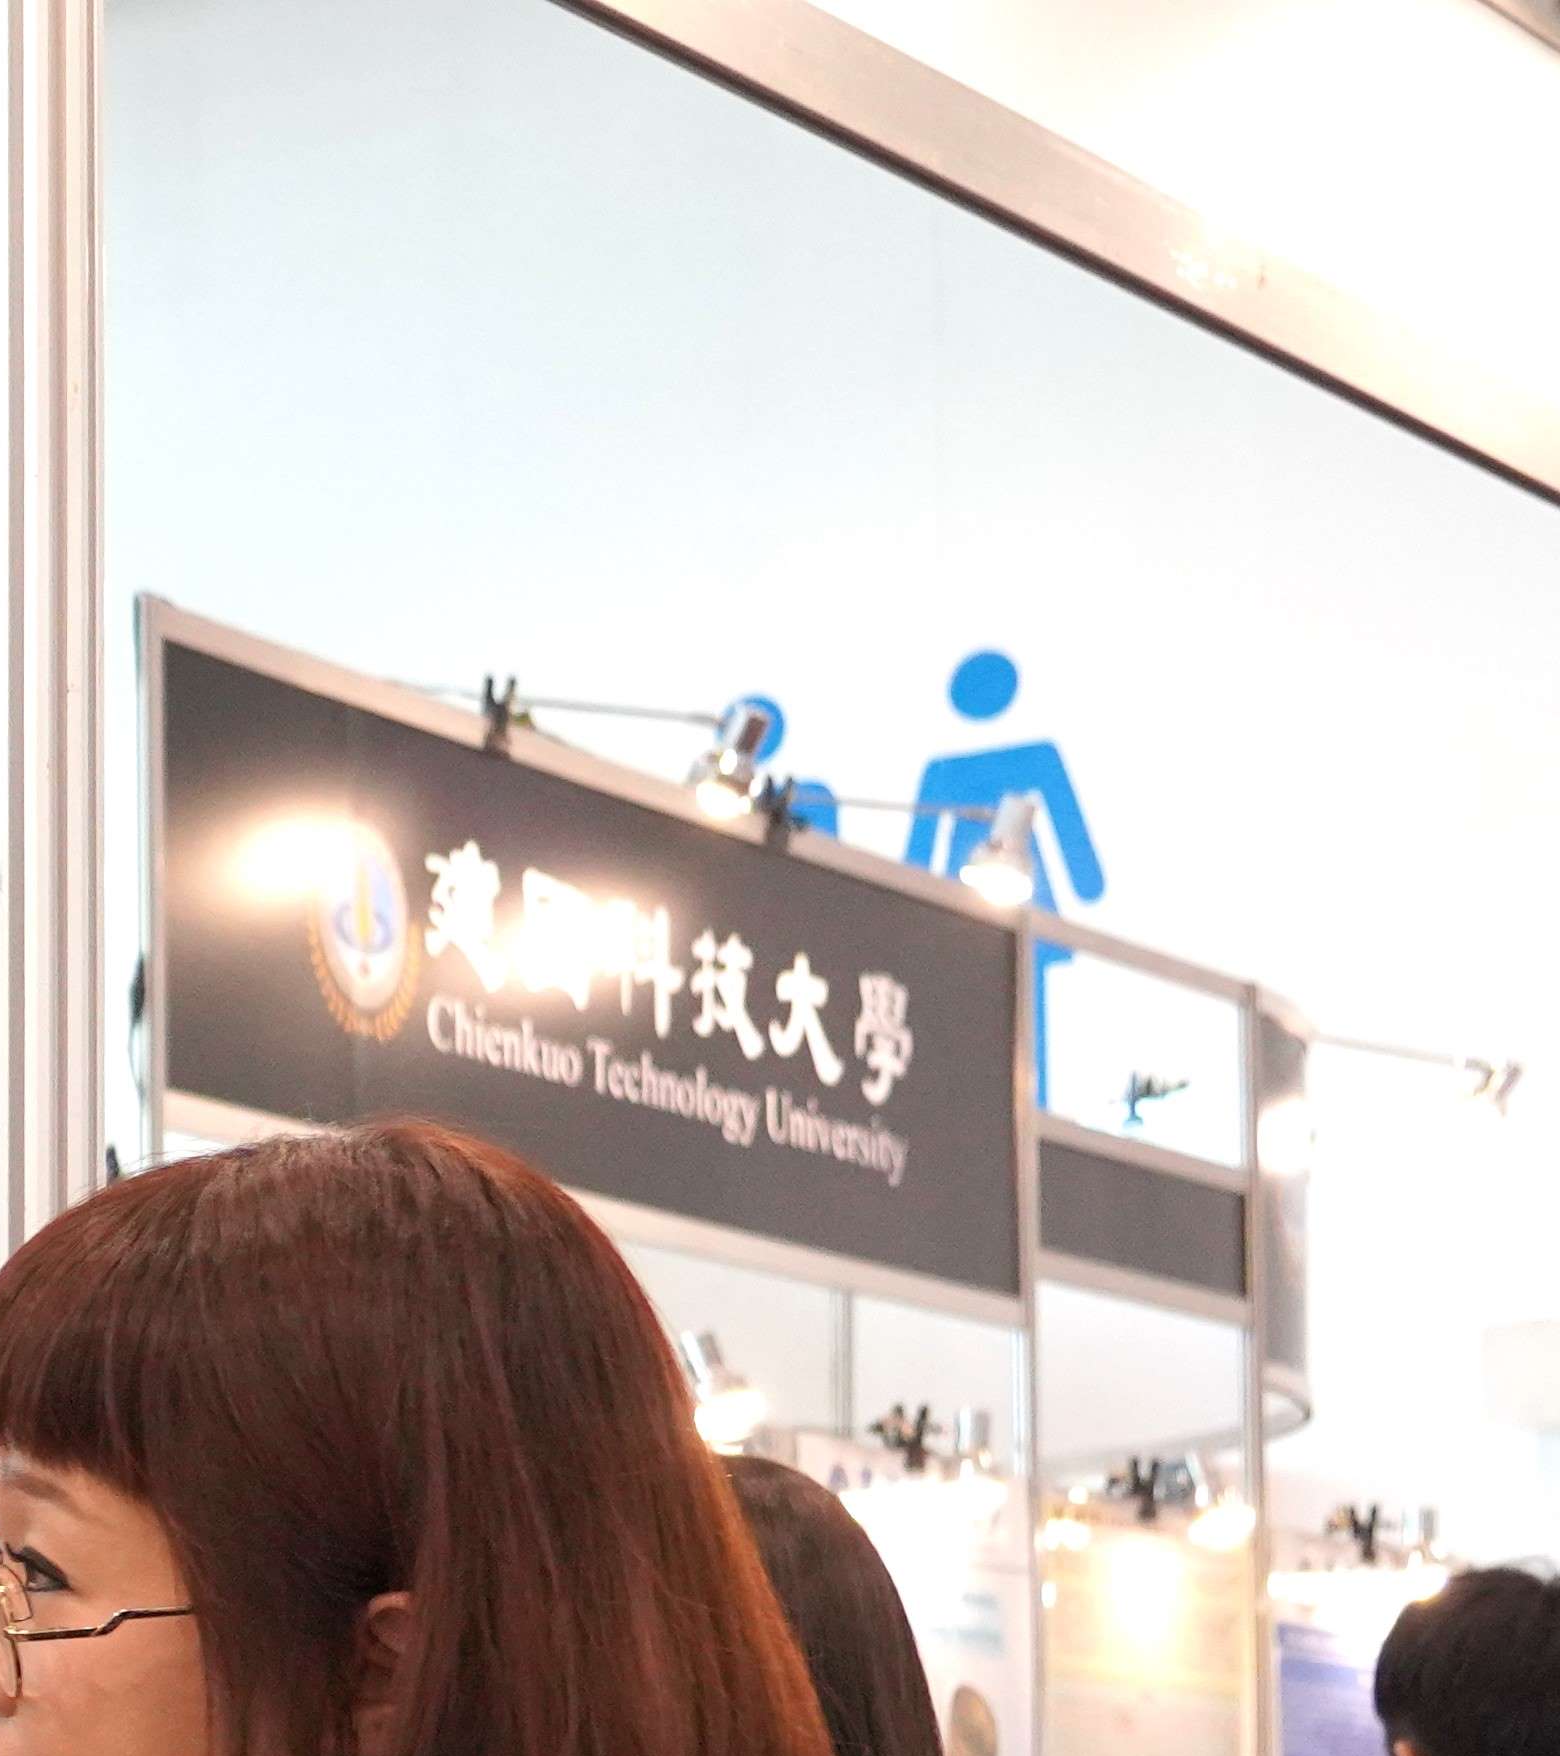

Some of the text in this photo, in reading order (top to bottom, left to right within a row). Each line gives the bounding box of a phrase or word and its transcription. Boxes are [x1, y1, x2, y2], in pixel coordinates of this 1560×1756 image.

[425, 993, 910, 1188] Chienkuo Technology University
